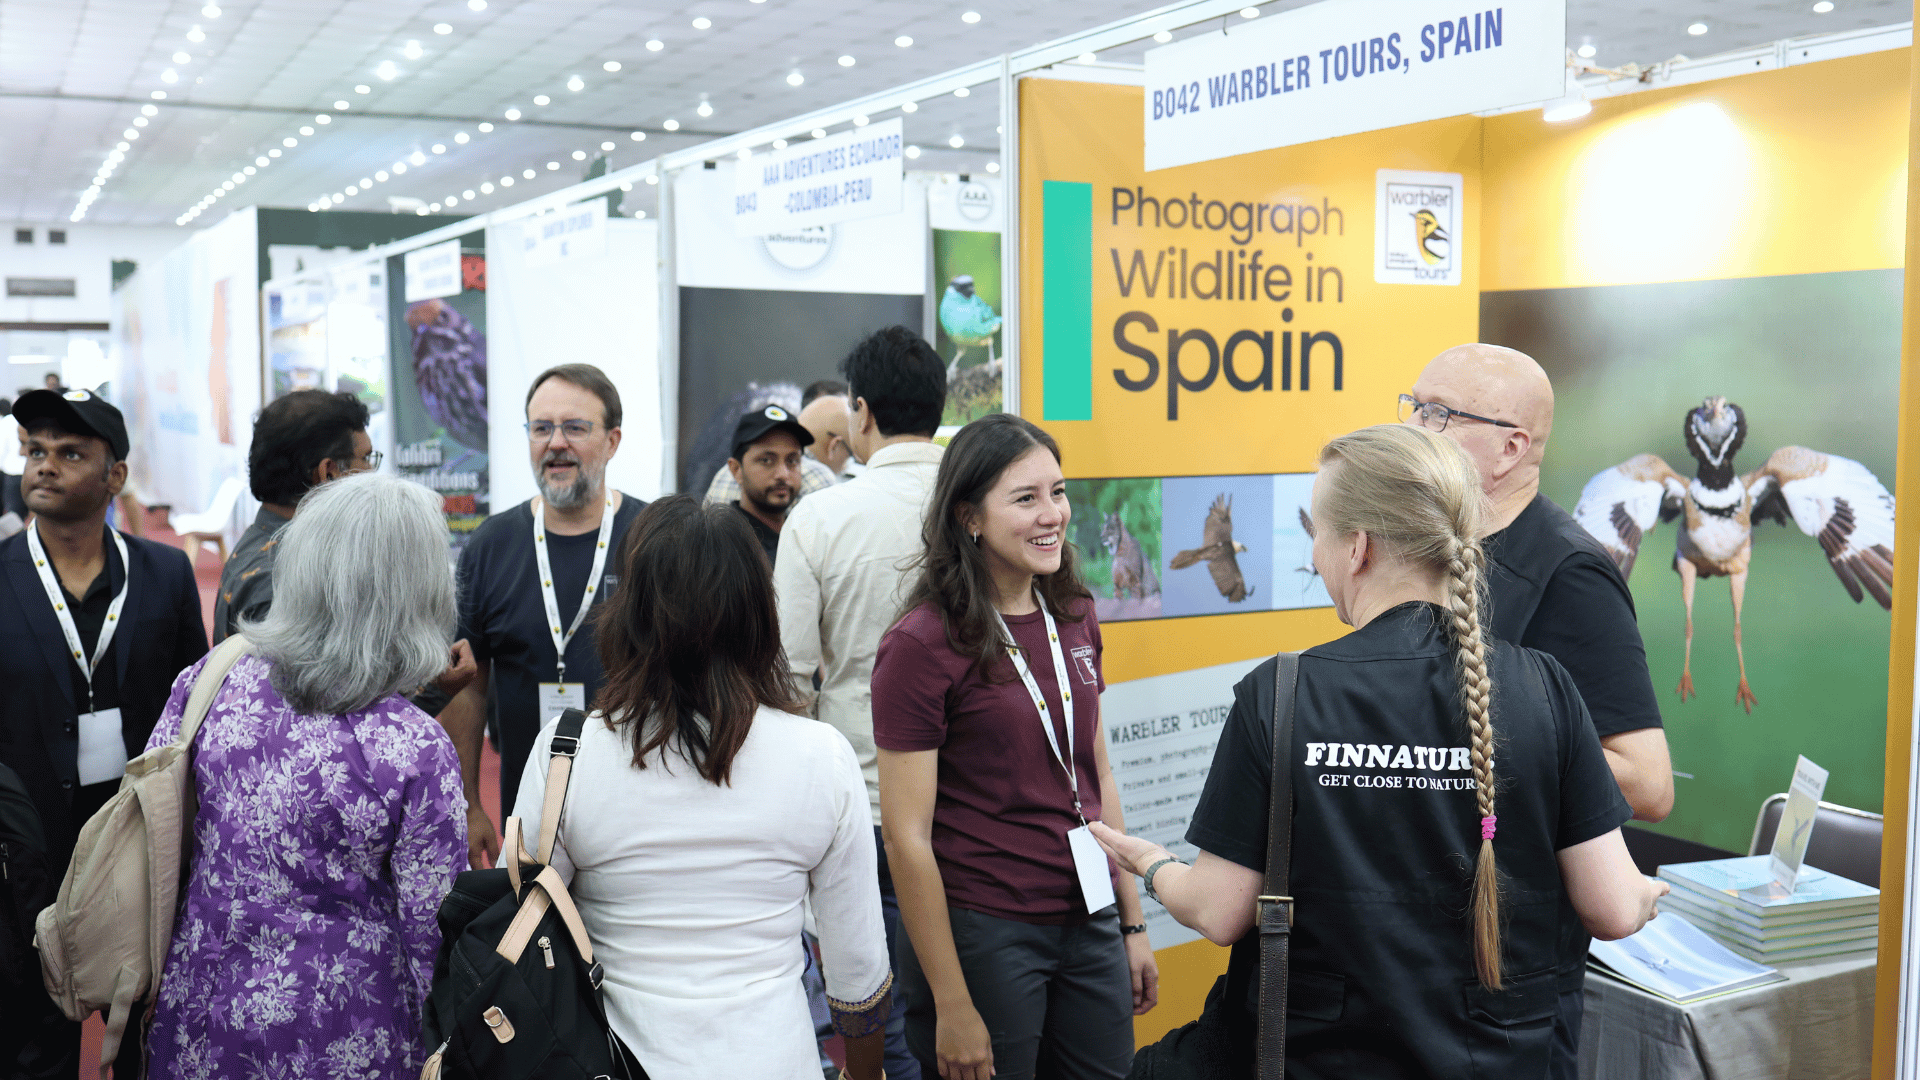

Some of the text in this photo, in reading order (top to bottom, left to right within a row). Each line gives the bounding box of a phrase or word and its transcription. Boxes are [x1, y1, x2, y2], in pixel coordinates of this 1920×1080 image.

[1153, 8, 1503, 121] B042 WARBLER TOURS, SPAIN
[783, 146, 846, 181] ADVENTURES
[849, 134, 901, 168] ECUADOR
[1112, 187, 1344, 247] Photograph
[1390, 188, 1449, 207] warbler
[1110, 246, 1344, 303] Wildlife in
[1415, 267, 1448, 280] tours
[1112, 308, 1344, 421] Spain
[1110, 714, 1181, 745] WARBLER
[1304, 742, 1495, 771] FINNATUR
[1318, 774, 1480, 791] GET CLOSE TO NATUR
